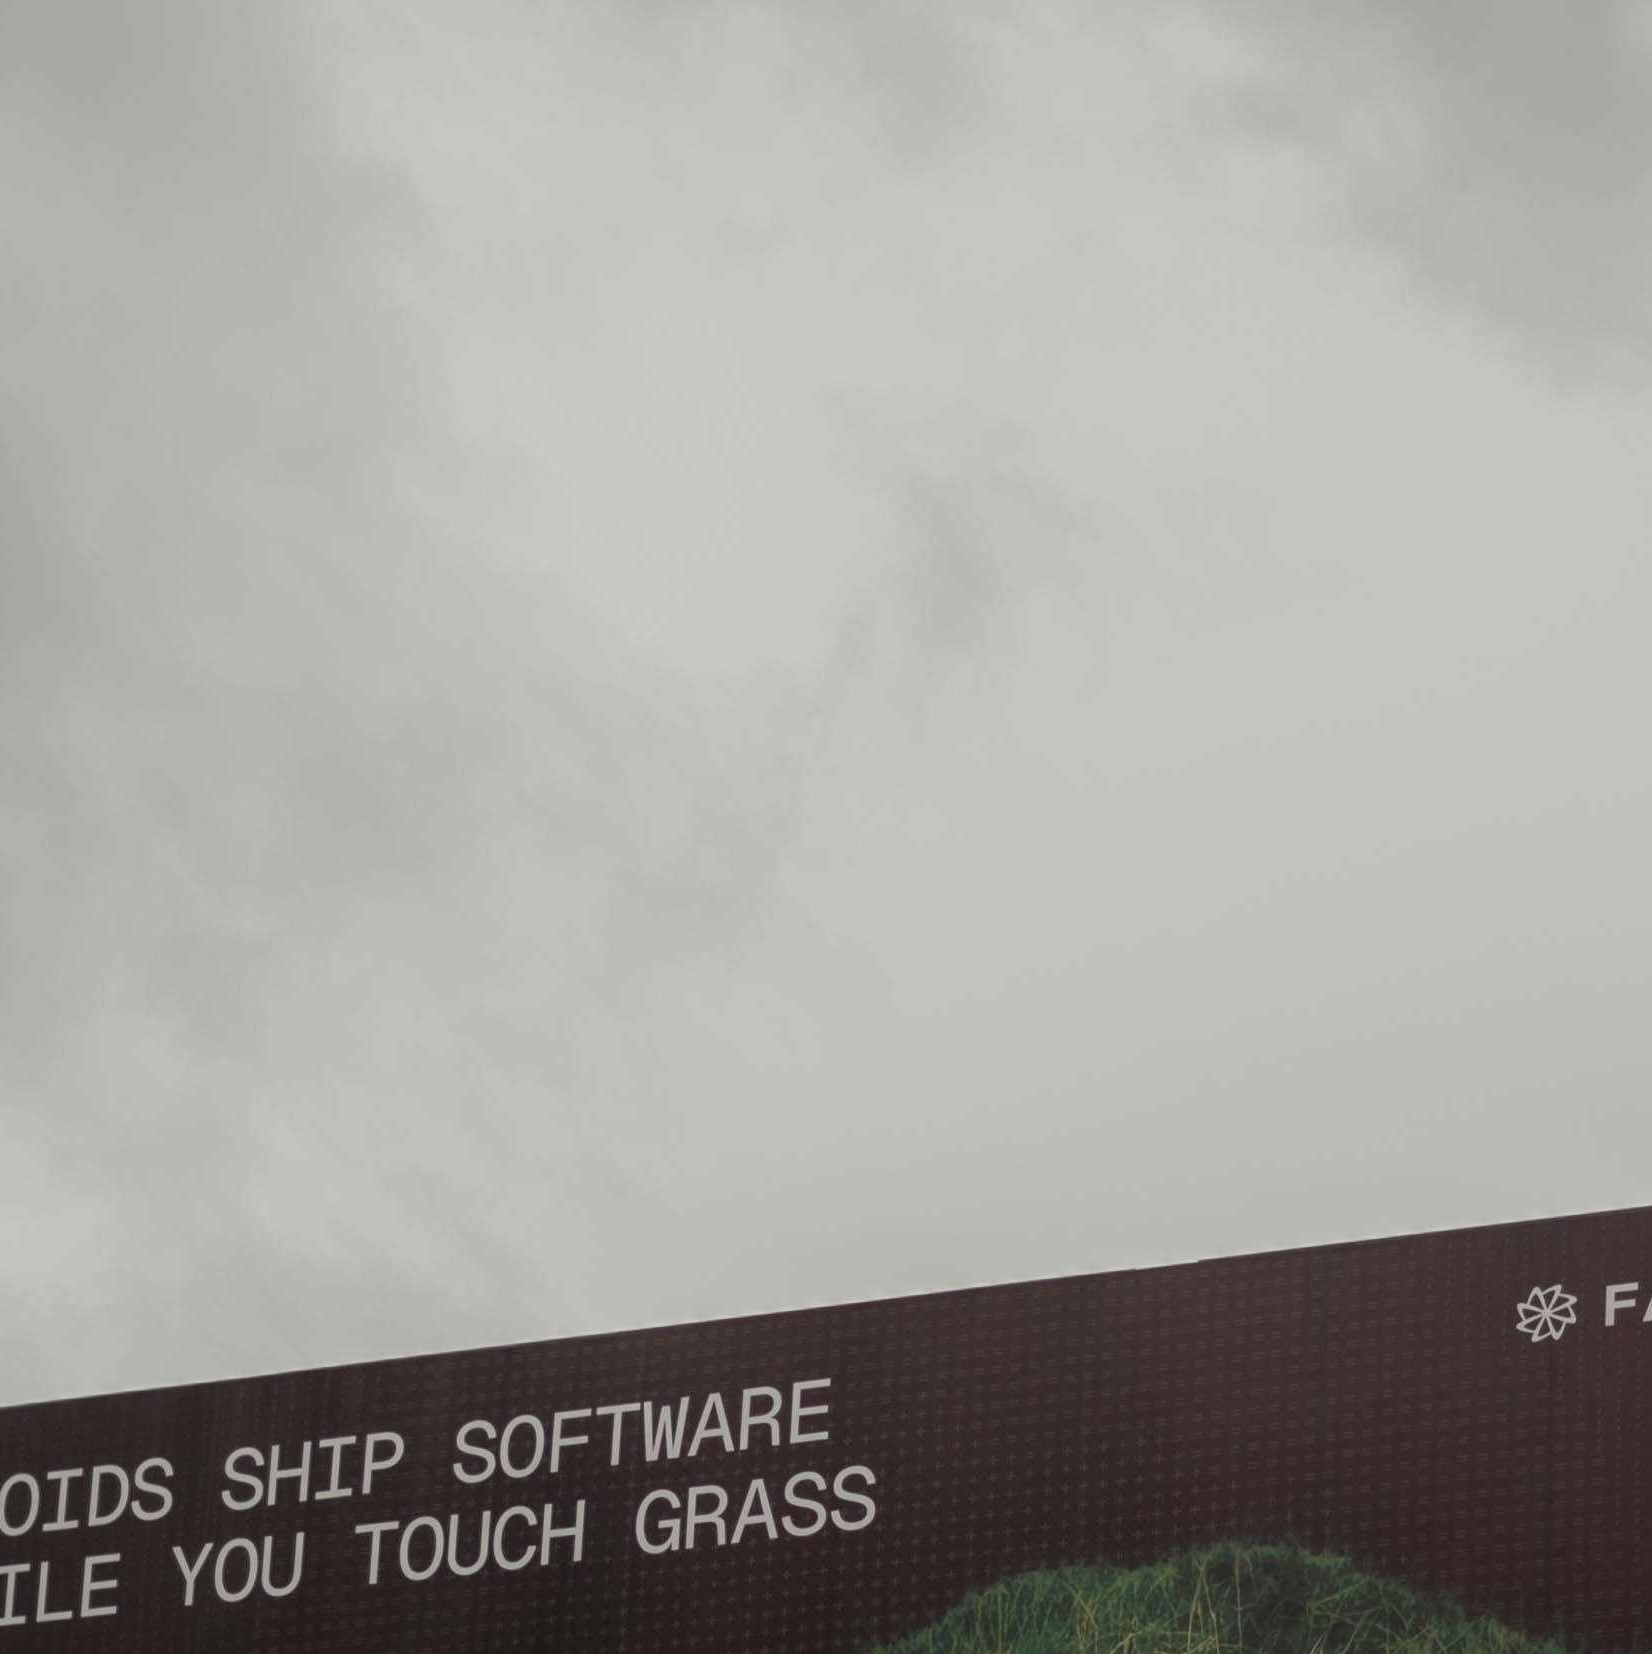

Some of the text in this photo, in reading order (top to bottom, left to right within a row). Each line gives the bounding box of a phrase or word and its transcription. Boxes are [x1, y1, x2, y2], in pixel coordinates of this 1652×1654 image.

[221, 1431, 405, 1511] SHIP
[452, 1377, 832, 1484] SOFTWARE
[172, 1531, 305, 1607] YOU
[354, 1499, 586, 1585] TOUCH
[635, 1465, 877, 1555] GRASS
